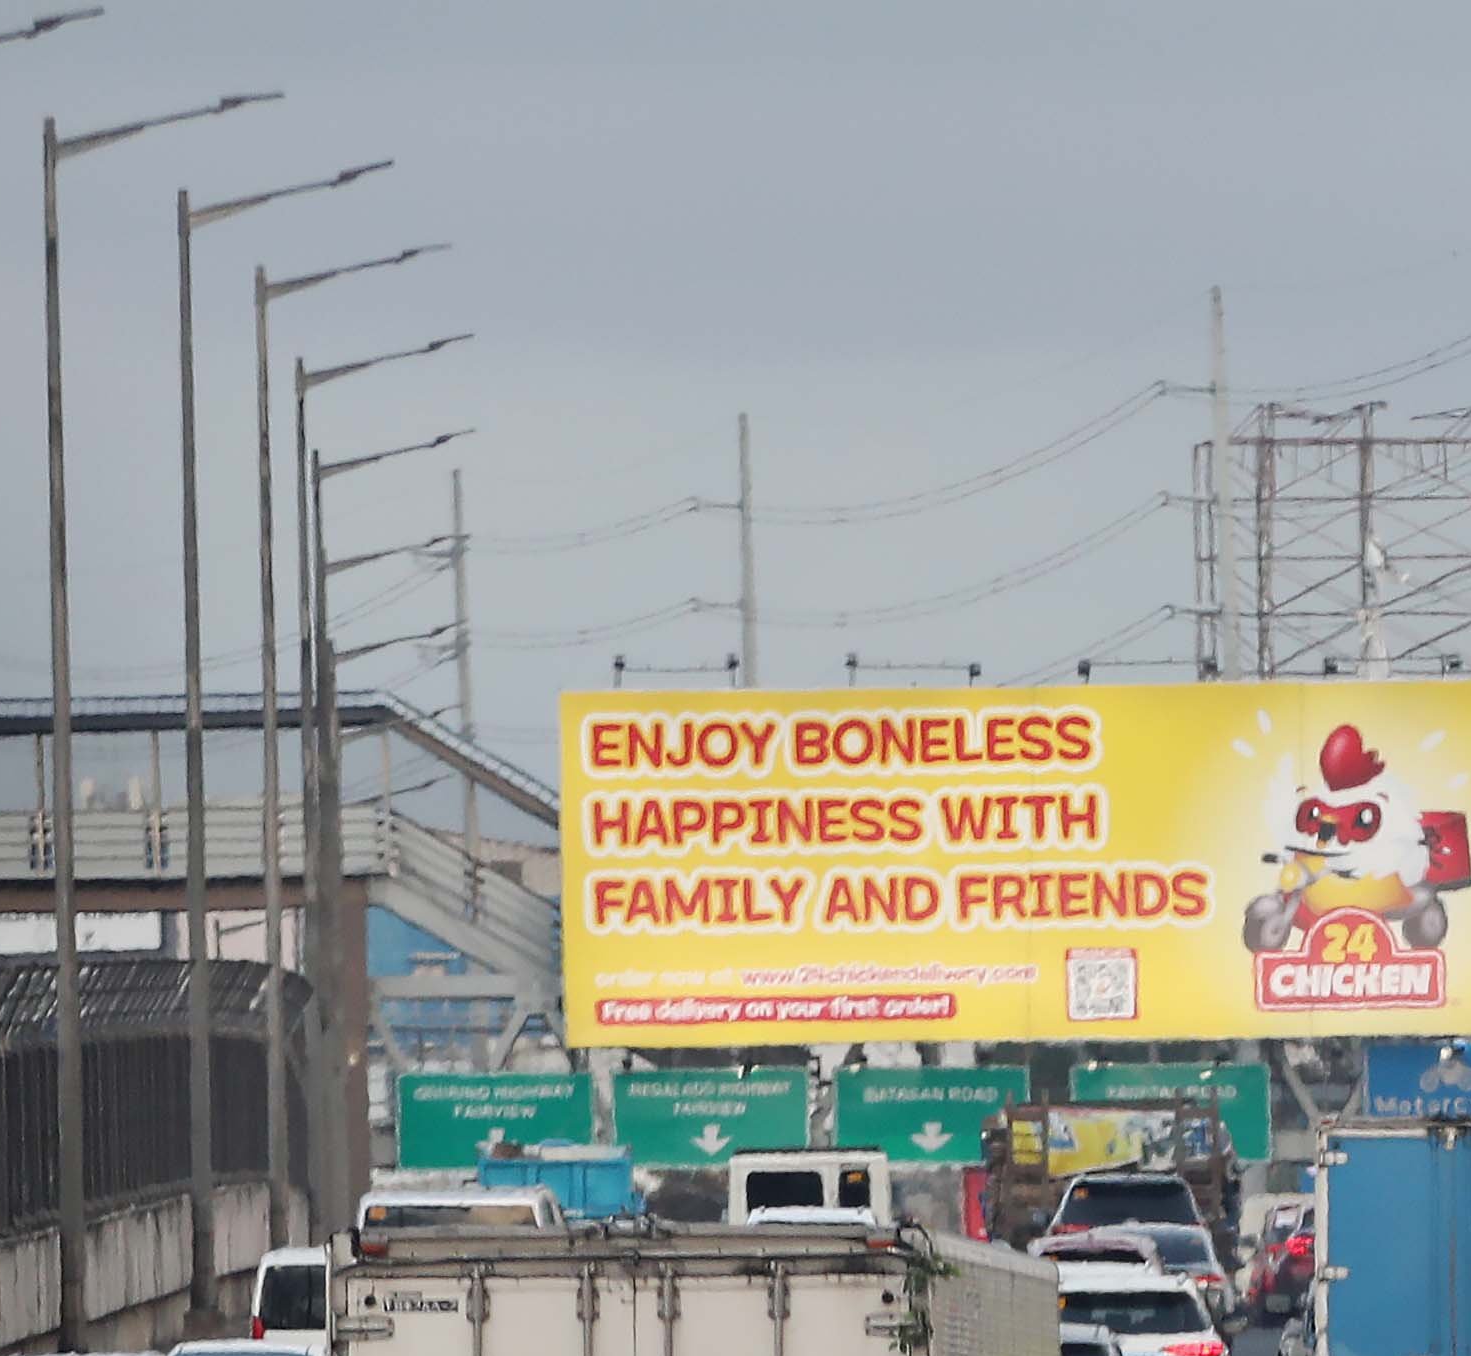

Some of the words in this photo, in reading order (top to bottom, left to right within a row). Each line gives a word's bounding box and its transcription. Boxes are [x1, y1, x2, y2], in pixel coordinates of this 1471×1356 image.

[591, 721, 776, 769] ENJOY
[794, 716, 1093, 765] BONELESS
[591, 798, 923, 847] HAPPINESS
[941, 795, 1099, 842] WITH
[593, 877, 805, 927] FAMILY
[826, 874, 939, 923] AND
[959, 872, 1210, 920] FRIENDS
[1322, 922, 1378, 963] 24
[1268, 961, 1434, 999] CHICKEN
[602, 1002, 654, 1022] Free
[656, 998, 741, 1024] delivery
[745, 1001, 772, 1019] on
[774, 1000, 826, 1022] your
[831, 996, 880, 1018] first
[883, 994, 950, 1019] order!
[949, 1086, 999, 1102] ROAD
